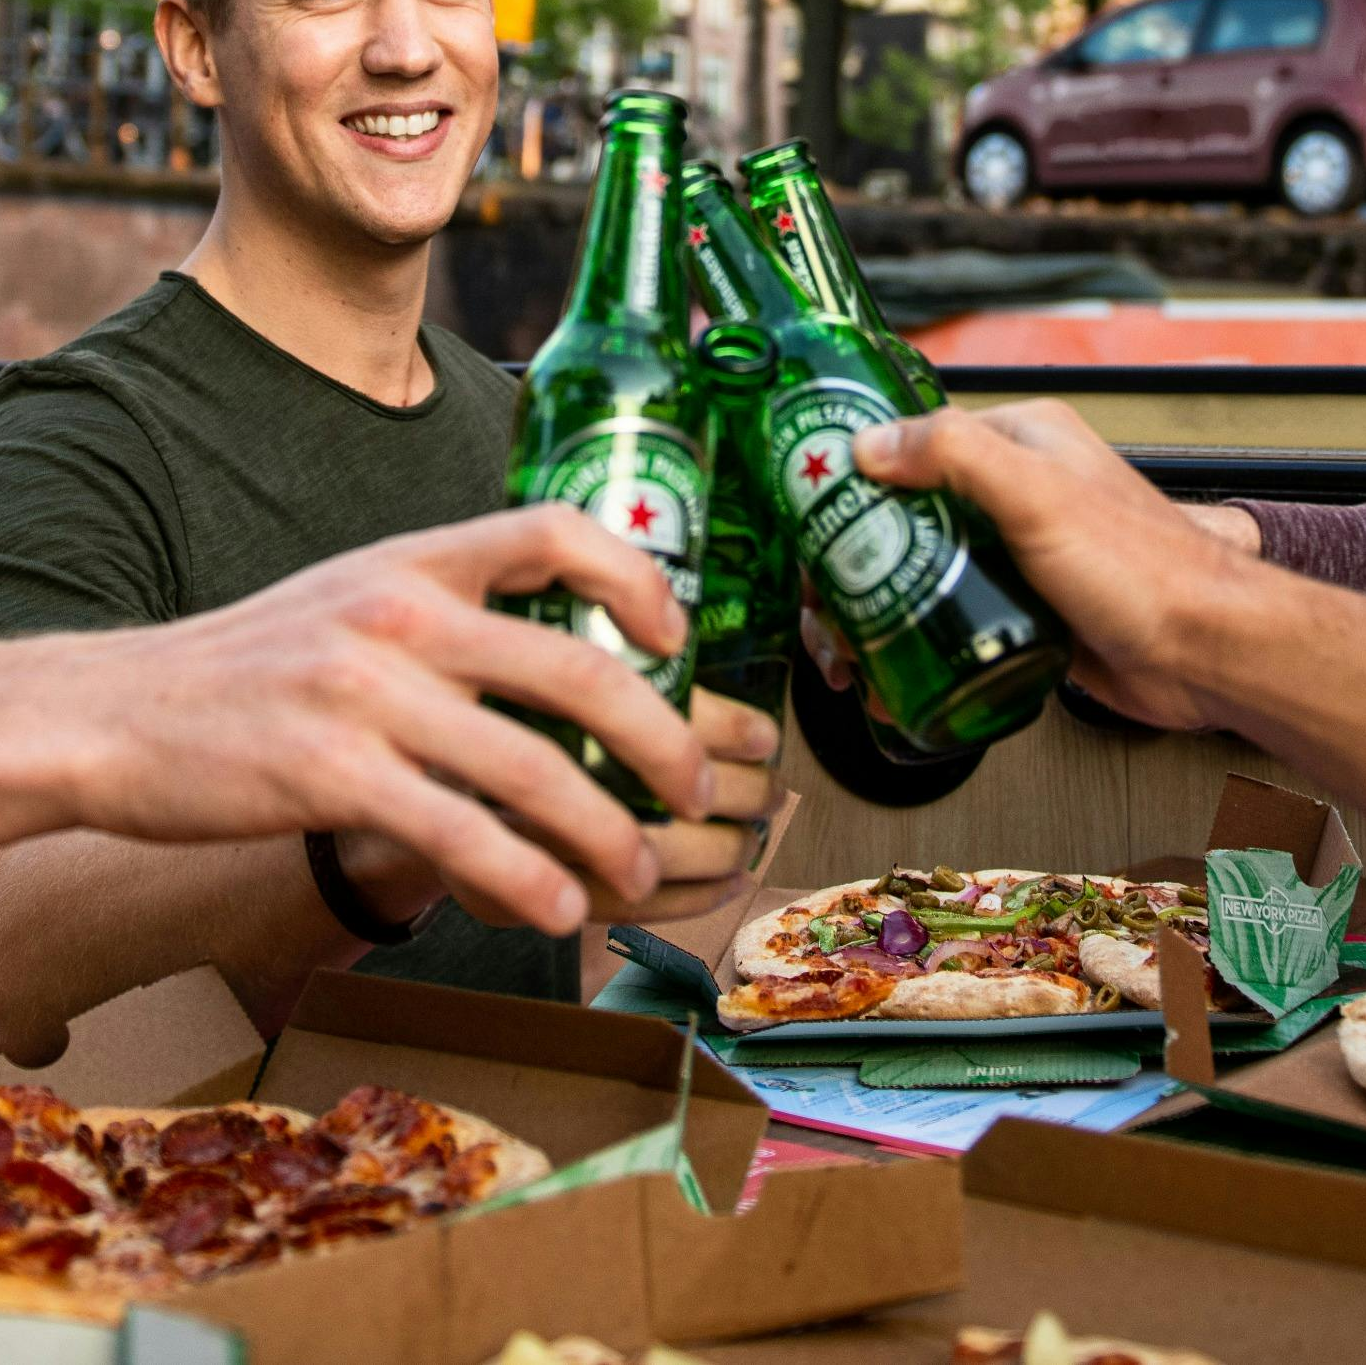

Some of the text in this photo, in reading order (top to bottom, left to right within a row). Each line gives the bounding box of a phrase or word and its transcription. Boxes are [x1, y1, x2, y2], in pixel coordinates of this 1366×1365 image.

[1225, 900, 1320, 925] NEW YORK PIZZA
[966, 1065, 1023, 1077] ENJOY!
